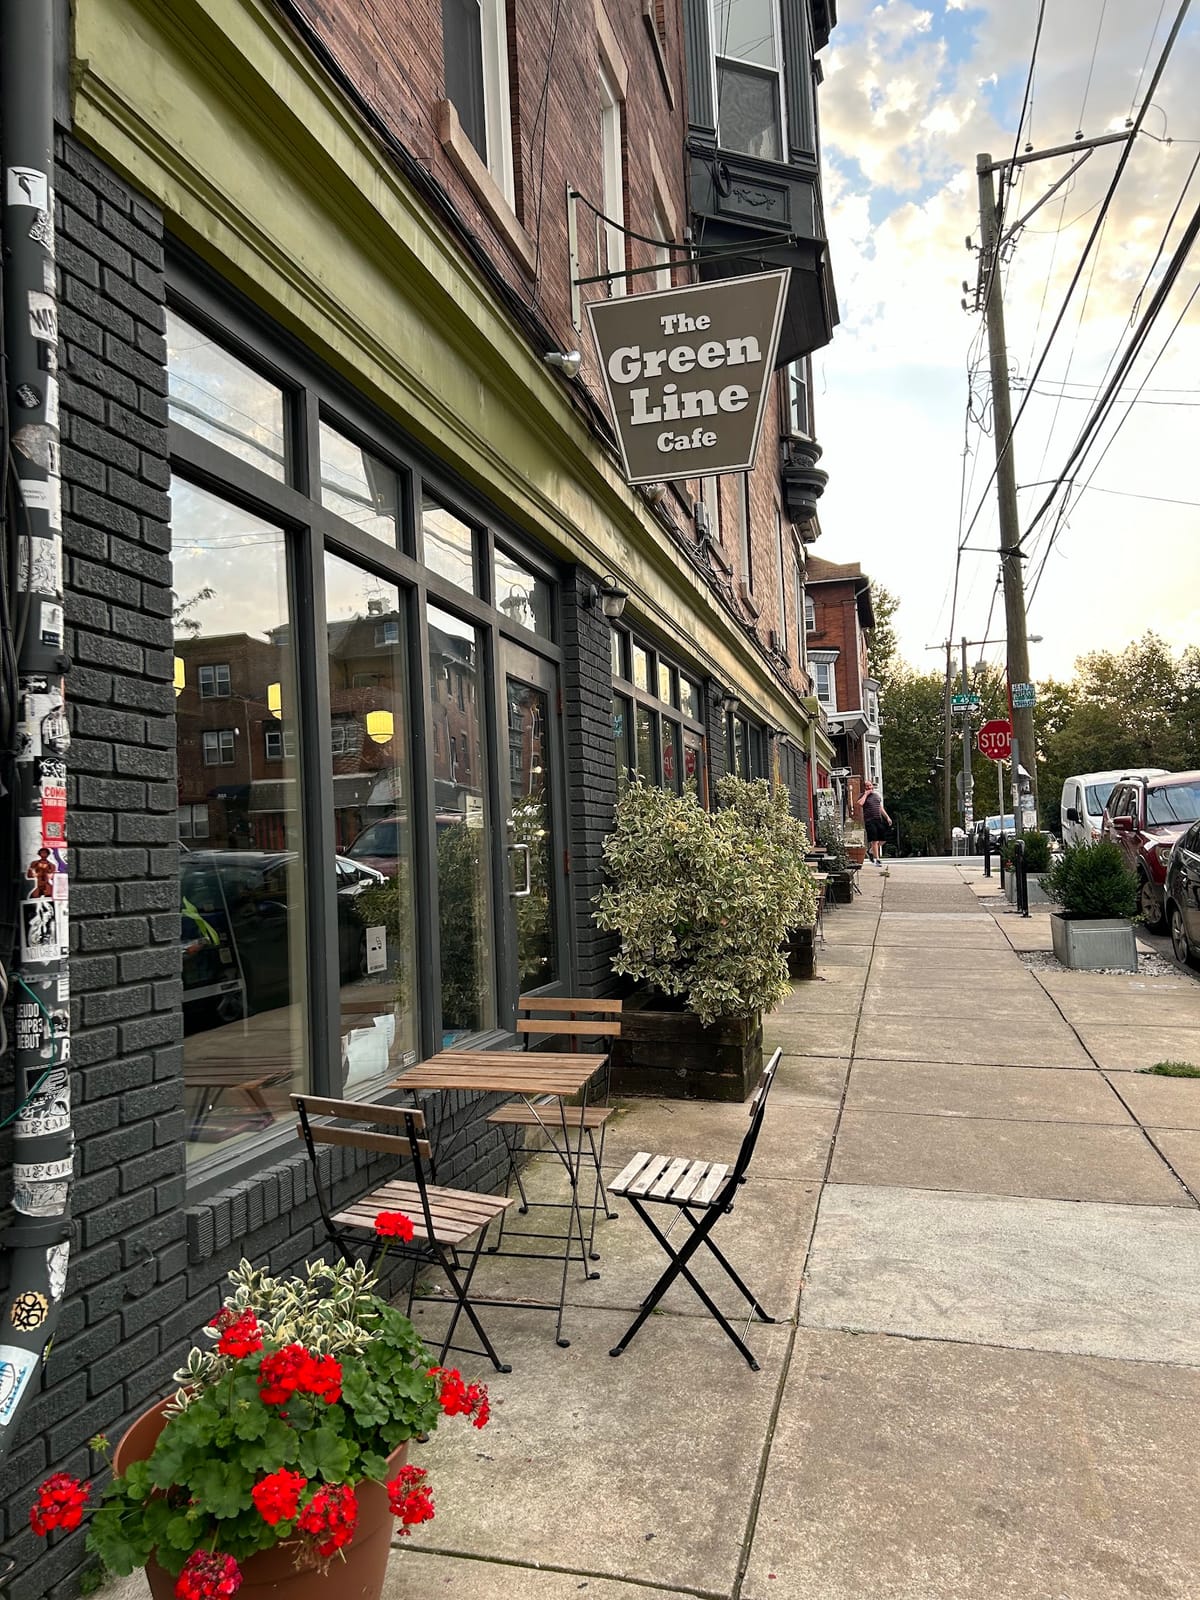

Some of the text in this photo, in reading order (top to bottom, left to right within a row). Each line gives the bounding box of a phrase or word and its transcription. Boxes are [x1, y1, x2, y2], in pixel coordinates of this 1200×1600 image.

[660, 313, 711, 335] The
[608, 335, 762, 384] Green
[630, 383, 749, 426] Line
[657, 427, 717, 453] Cafe
